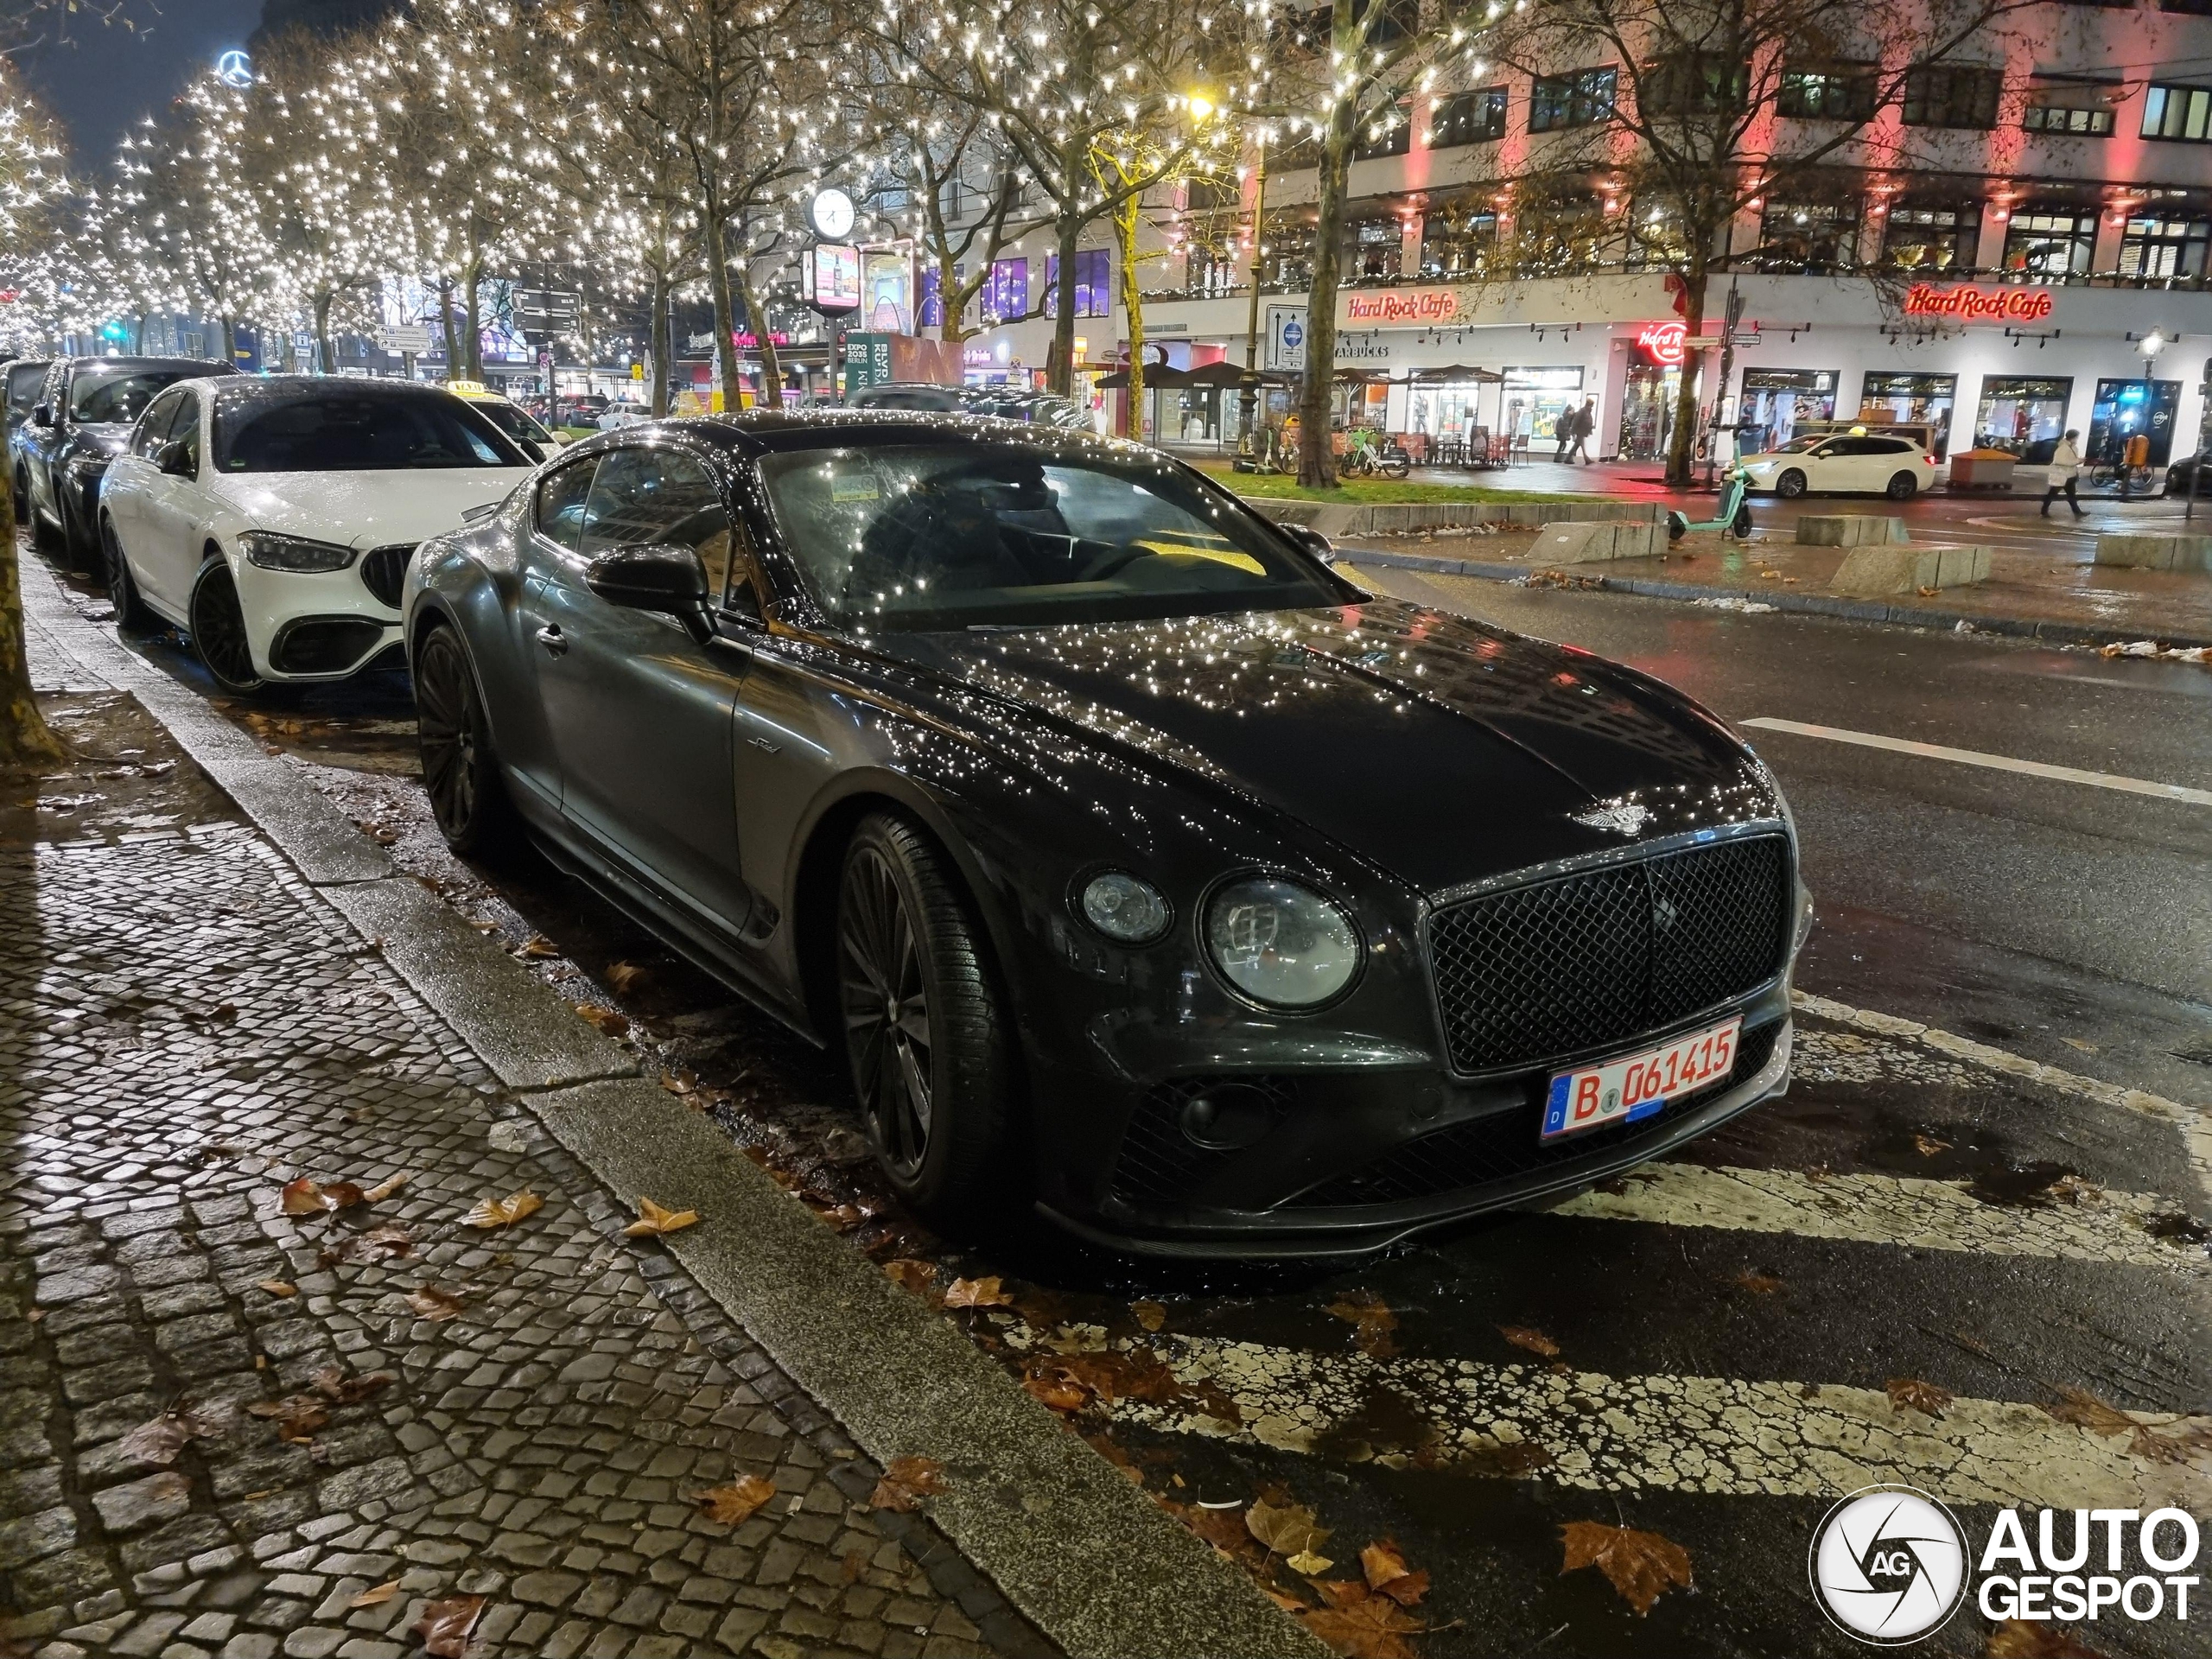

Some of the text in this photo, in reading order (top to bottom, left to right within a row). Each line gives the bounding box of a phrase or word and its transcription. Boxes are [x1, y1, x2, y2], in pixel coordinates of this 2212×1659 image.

[1348, 293, 1453, 321] Hard Rock Cafe
[1908, 288, 2052, 321] Hard Rock Cafe
[1638, 331, 1672, 346] Hard
[1334, 346, 1389, 359] TARBUCKS
[1574, 1028, 1733, 1121] B 061415
[1550, 1111, 1560, 1124] D
